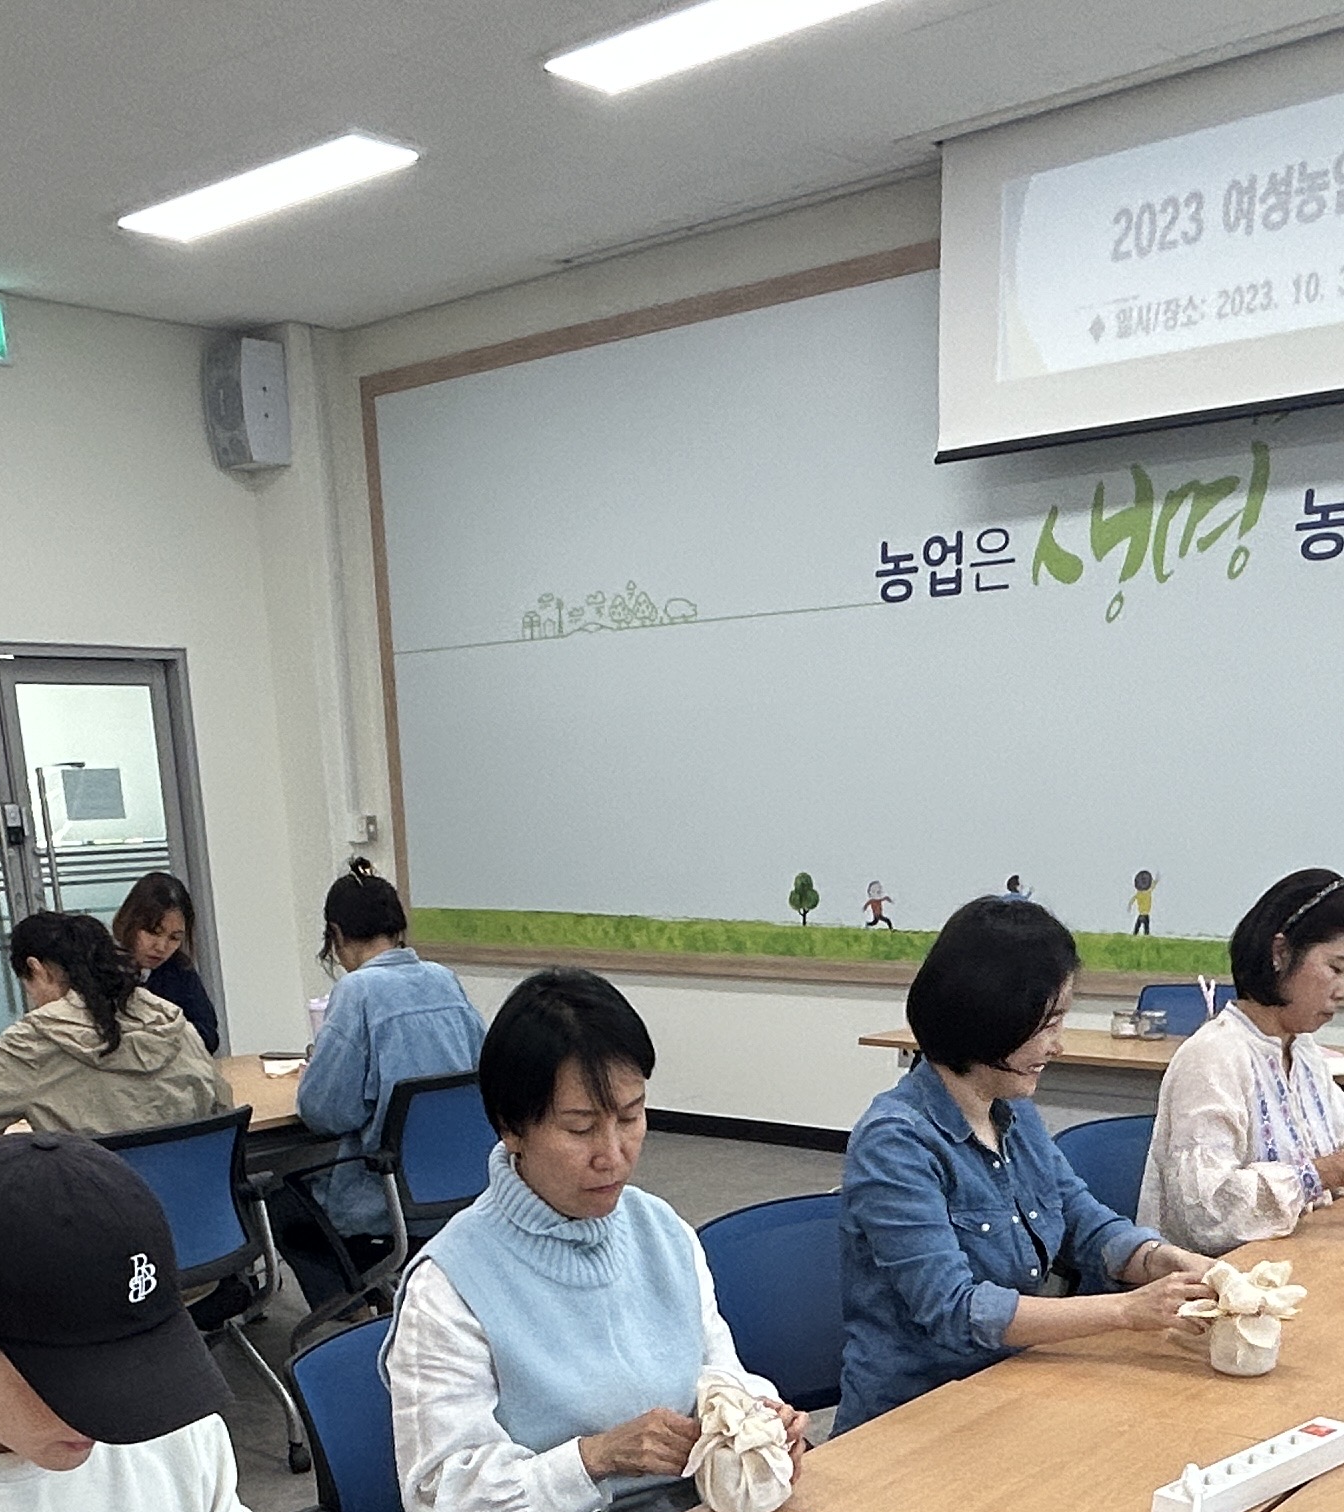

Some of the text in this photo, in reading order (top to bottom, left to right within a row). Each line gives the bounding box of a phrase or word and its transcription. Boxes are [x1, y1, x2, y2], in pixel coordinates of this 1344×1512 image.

[1111, 191, 1204, 263] 2023
[1216, 279, 1279, 321] 2023.
[1292, 271, 1325, 305] 10.
[875, 526, 1016, 604] 농업은
[1031, 440, 1270, 624] 생명
